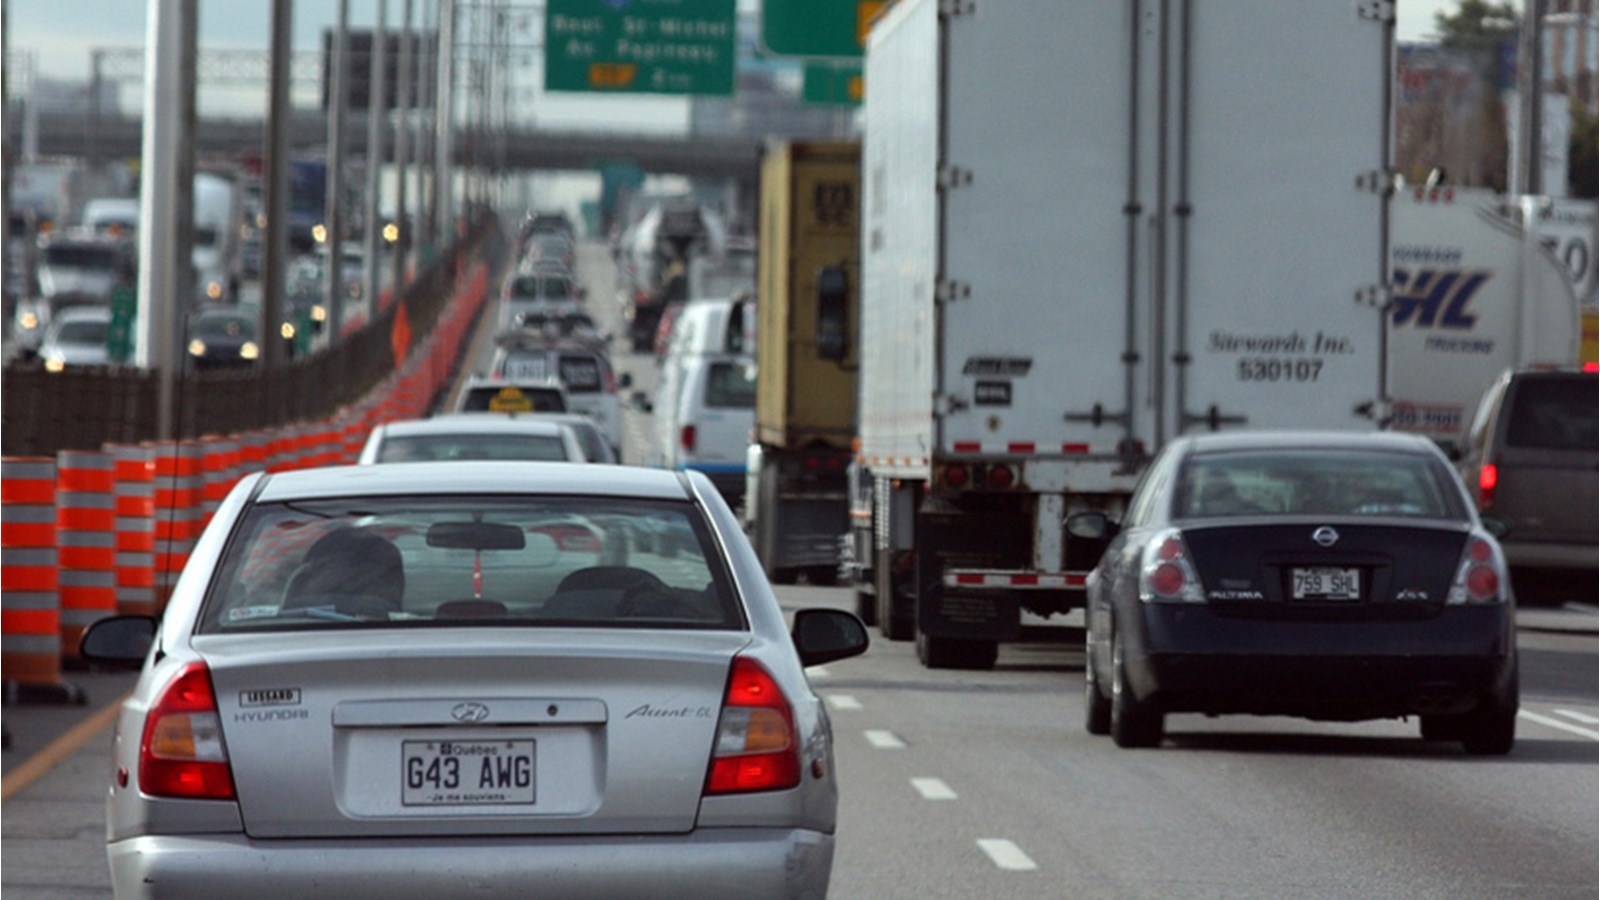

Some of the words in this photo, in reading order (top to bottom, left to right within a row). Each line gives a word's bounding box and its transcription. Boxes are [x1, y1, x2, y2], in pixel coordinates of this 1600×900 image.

[1207, 330, 1306, 353] Stewards
[1313, 331, 1355, 354] Inc.
[1238, 358, 1324, 382] 530107
[1296, 575, 1322, 592] 759
[234, 708, 309, 722] HYUNDAI
[624, 704, 688, 719] Accent
[452, 743, 498, 755] Québec
[408, 756, 460, 789] G43
[478, 755, 531, 789] AWG
[463, 793, 506, 802] souviens
